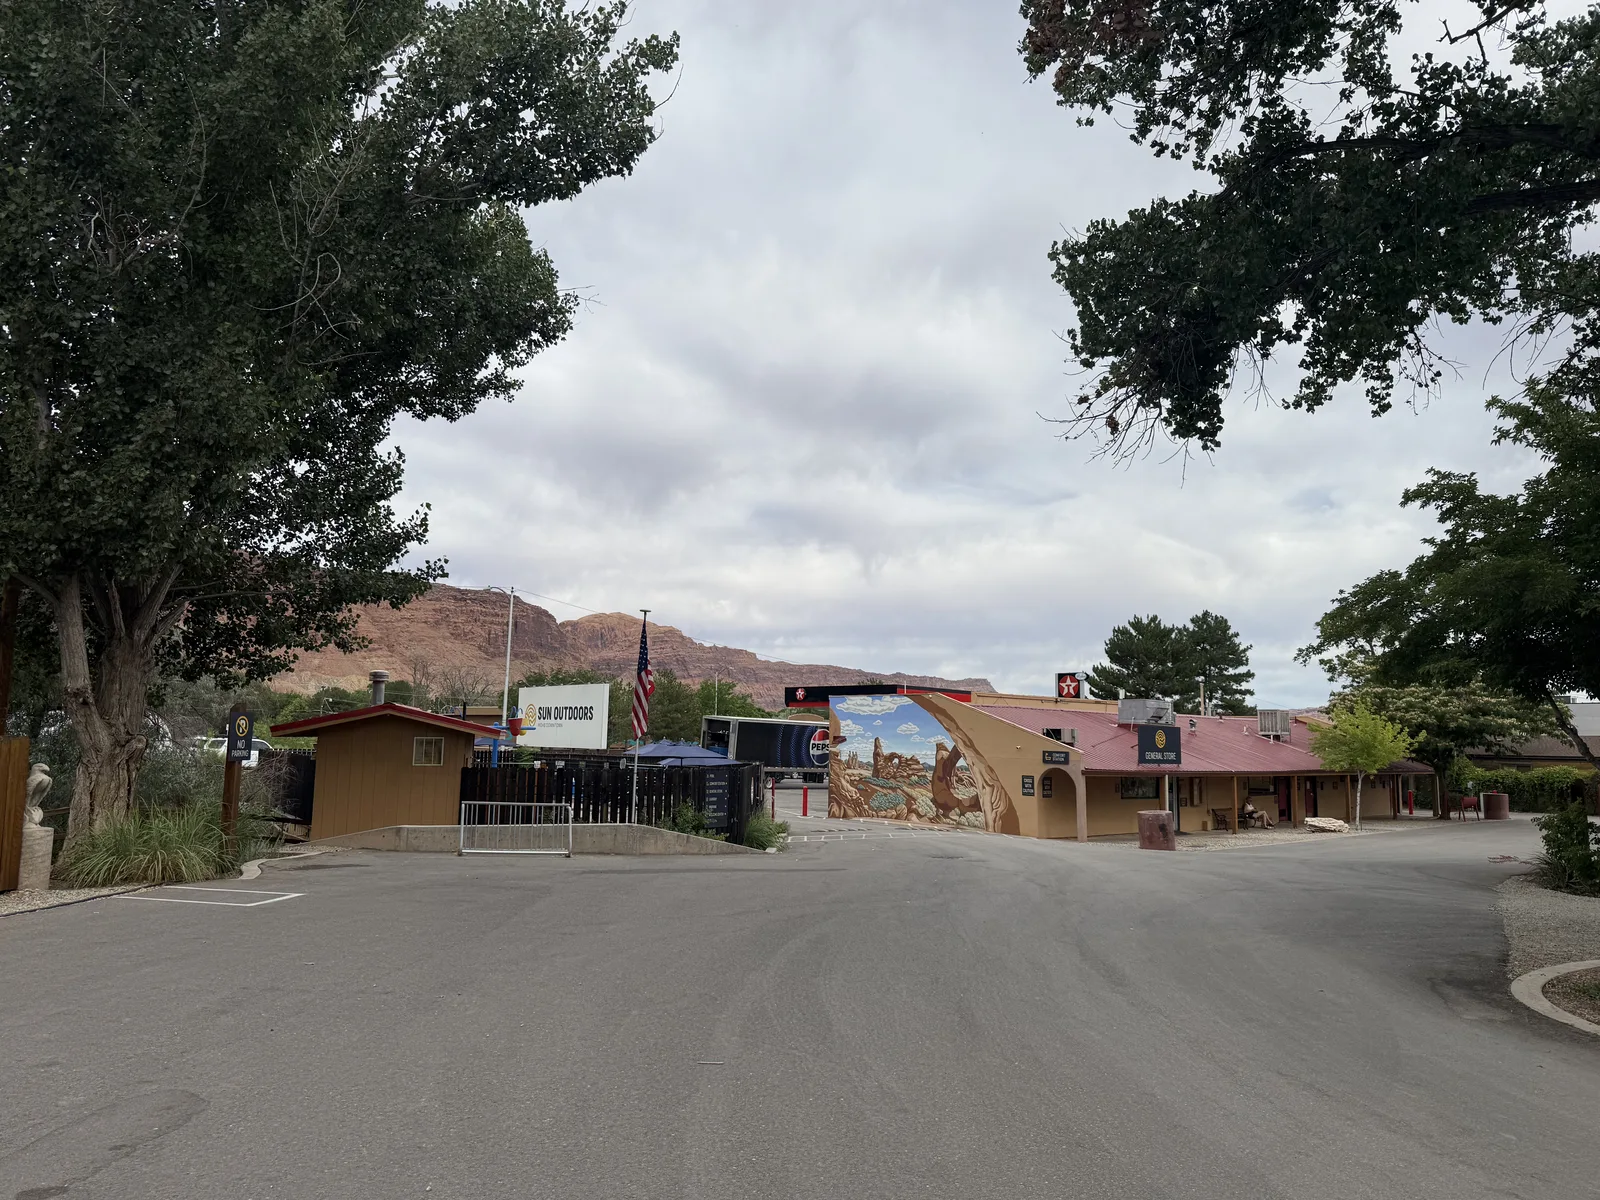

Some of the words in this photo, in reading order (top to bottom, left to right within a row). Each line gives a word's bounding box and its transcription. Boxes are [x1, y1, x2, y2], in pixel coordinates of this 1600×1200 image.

[538, 706, 552, 720] SUN
[554, 706, 594, 720] OUTDOORS
[237, 740, 246, 749] NO
[811, 743, 830, 751] PEPS
[1145, 751, 1163, 760] GENERAL
[1163, 752, 1177, 760] STORE
